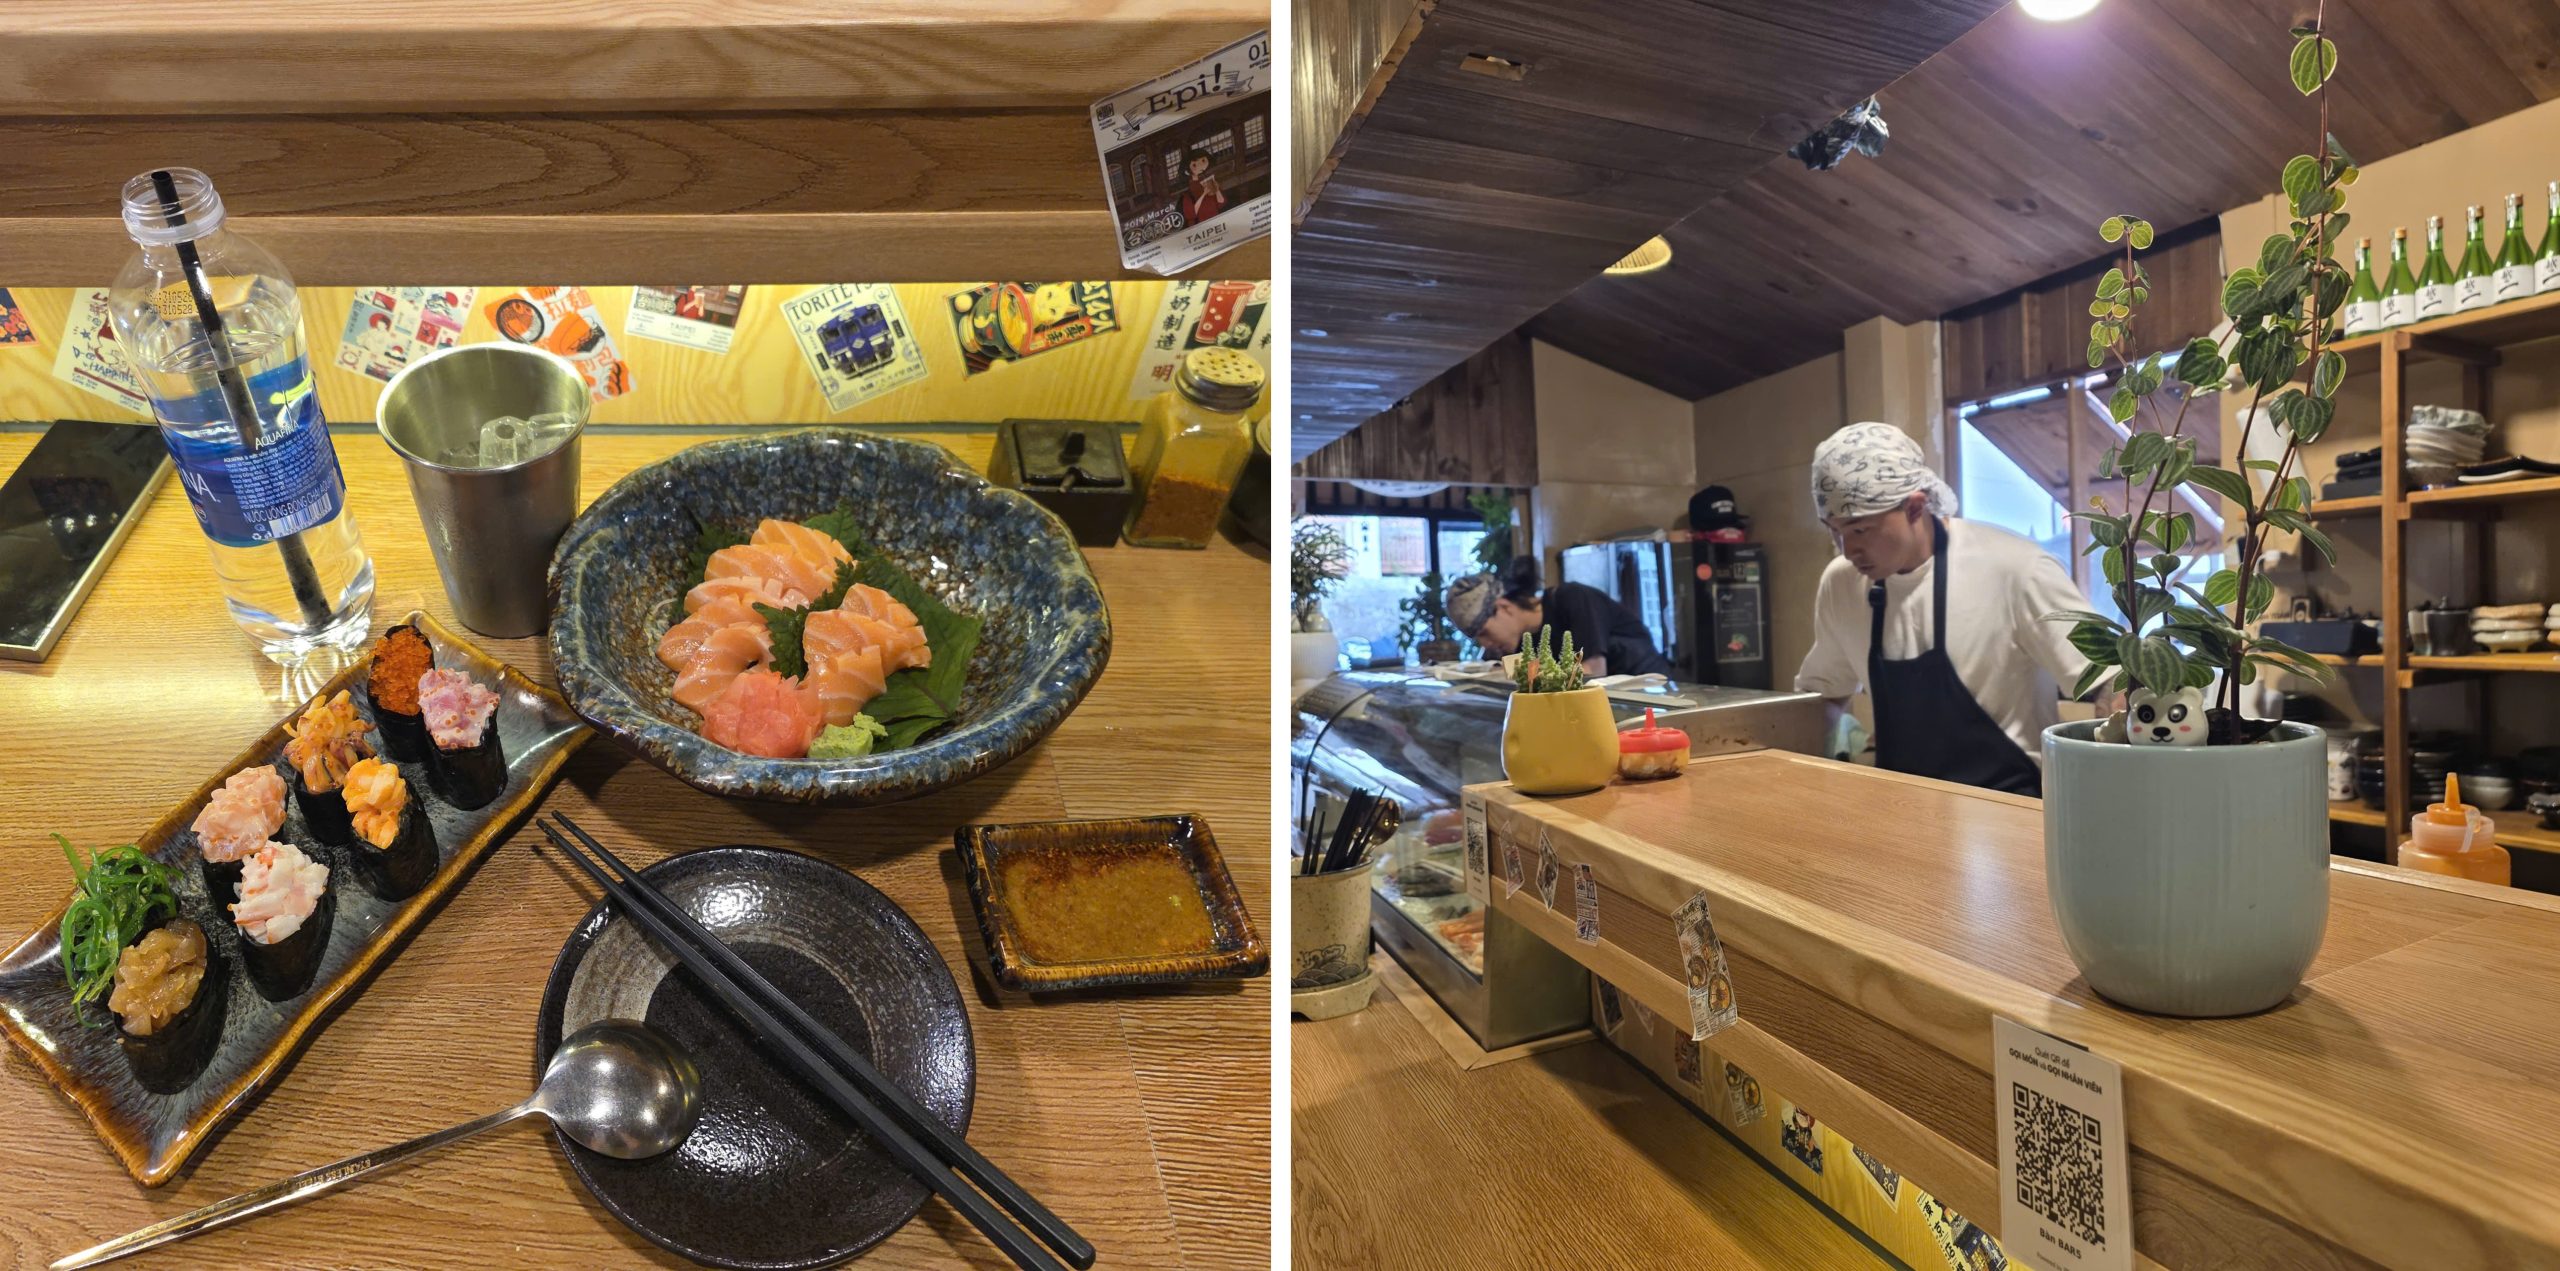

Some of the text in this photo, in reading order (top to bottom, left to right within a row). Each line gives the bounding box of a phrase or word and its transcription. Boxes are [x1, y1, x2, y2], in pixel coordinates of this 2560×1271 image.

[1248, 40, 1270, 61] 01
[1146, 63, 1222, 113] Epi!
[1186, 222, 1227, 244] TAIPEI
[255, 419, 300, 450] AQUAFINA
